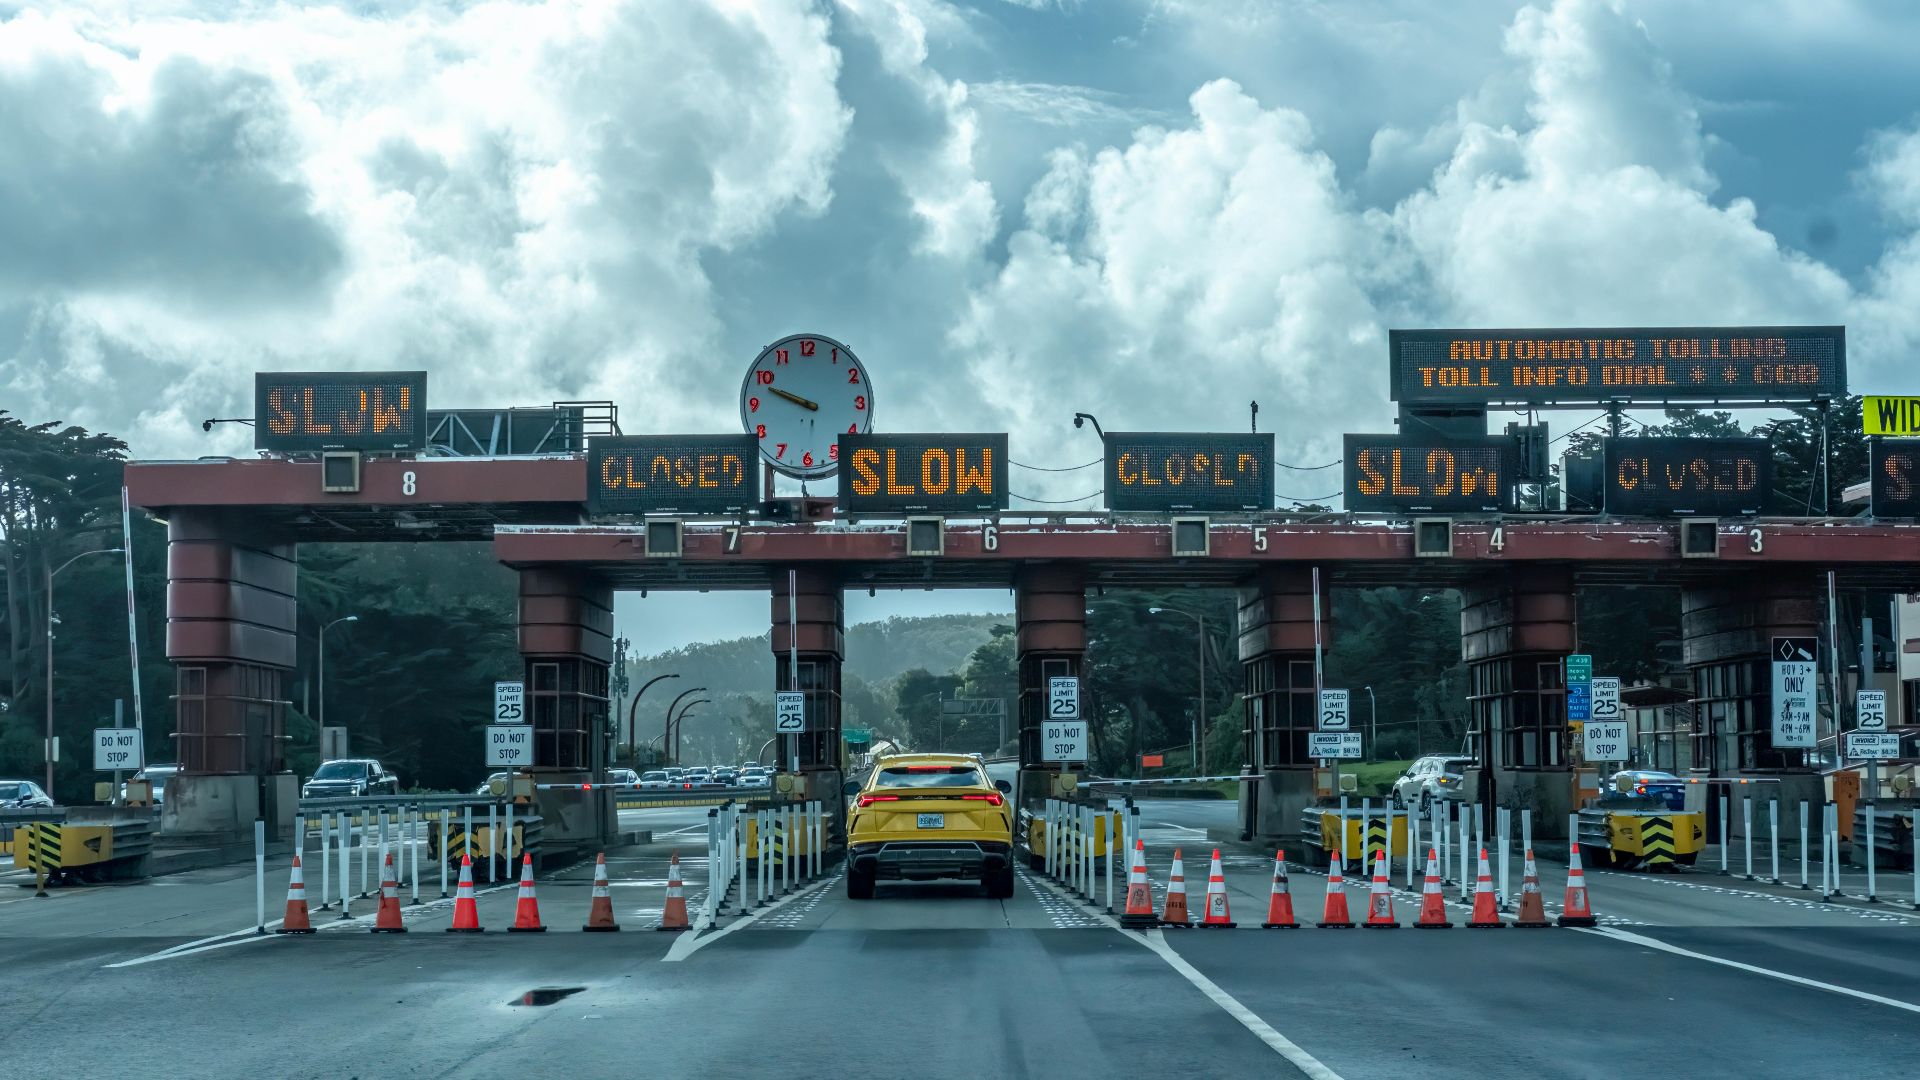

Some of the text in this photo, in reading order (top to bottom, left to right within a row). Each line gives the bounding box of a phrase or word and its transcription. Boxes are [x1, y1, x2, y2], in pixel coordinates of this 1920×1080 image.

[800, 340, 815, 356] 12
[1450, 338, 1786, 360] AUTOMATIC TOLLING
[776, 350, 788, 365] 11
[832, 348, 838, 364] 1
[756, 370, 774, 385] 10
[848, 368, 859, 384] 2
[1419, 367, 1498, 387] TOLL
[1512, 366, 1588, 386] INFO
[1602, 365, 1676, 385] DIAL
[750, 398, 759, 412] 9
[855, 396, 865, 410] 3
[757, 424, 766, 438] 8
[776, 444, 787, 460] 7
[803, 452, 813, 467] 6
[829, 444, 838, 460] 5
[852, 448, 992, 495] SLOW
[403, 471, 416, 495] 8
[725, 528, 739, 551] 7
[984, 526, 998, 550] 6
[1254, 527, 1267, 550] 5
[1490, 528, 1504, 550] 4
[1750, 529, 1762, 552] 3
[1782, 664, 1796, 675] HOV
[1785, 677, 1804, 693] ONLY
[498, 704, 521, 719] 25
[1052, 699, 1076, 714] 25
[1594, 700, 1617, 715] 25
[779, 714, 802, 728] 25
[1323, 711, 1346, 726] 25
[1861, 712, 1883, 727] 25
[494, 734, 525, 743] DO NOT
[1049, 728, 1080, 738] DO NOT
[1590, 729, 1621, 739] DO NOT
[102, 736, 133, 746] DO NOT
[499, 749, 520, 758] STOP
[1054, 744, 1075, 754] STOP
[1596, 744, 1616, 754] STOP
[107, 752, 128, 762] STOP
